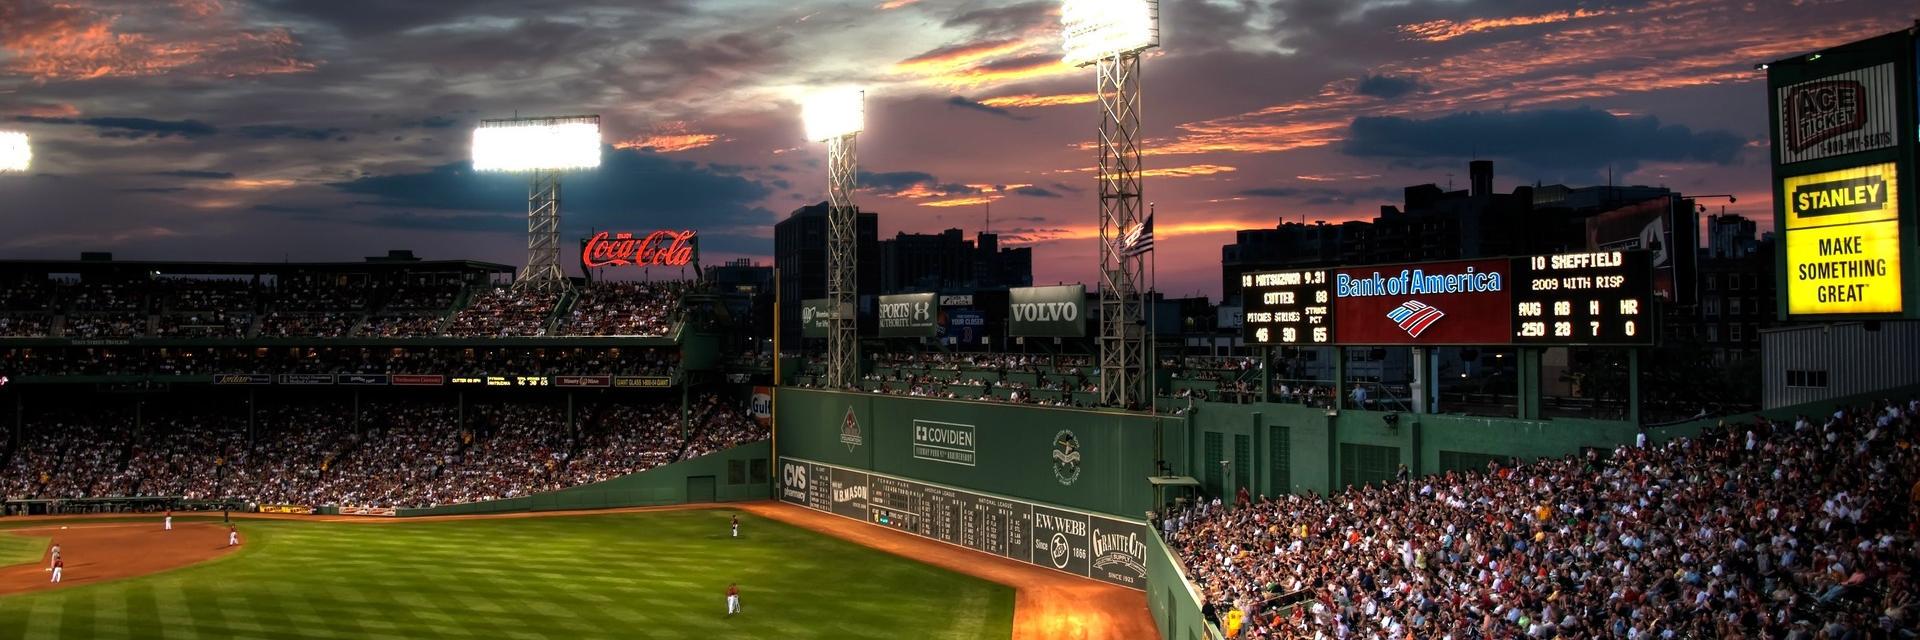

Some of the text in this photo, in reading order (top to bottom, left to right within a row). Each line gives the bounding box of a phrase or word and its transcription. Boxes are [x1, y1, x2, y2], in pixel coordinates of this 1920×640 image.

[1800, 87, 1856, 116] ACE
[1800, 109, 1856, 138] TICKET
[1798, 183, 1880, 211] STANLEY
[583, 230, 697, 267] Coca-Cola
[1818, 236, 1863, 257] MAKE
[1531, 252, 1622, 270] 10 SHEFFIELD
[1798, 258, 1887, 281] SOMETHING
[1304, 271, 1326, 285] 9.31
[1337, 266, 1502, 298] Bank of America
[1532, 276, 1624, 290] 2009 WITH RISP
[1264, 290, 1328, 305] CUTTER 88
[1011, 301, 1078, 322] VOLVO
[1518, 299, 1638, 316] AVG AB H HR
[1247, 312, 1272, 323] PITCHES
[1274, 312, 1301, 322] STRIKES
[1309, 316, 1323, 324] PCT
[1255, 327, 1327, 342] 46 30 65
[1516, 321, 1635, 336] .250 28 7 0
[928, 427, 973, 447] COVIDIEN
[783, 463, 806, 490] CVS
[783, 487, 807, 502] pharmacy
[924, 487, 942, 495] AMERICAN
[942, 489, 956, 497] LEAGUE
[978, 498, 1013, 509] NATIONAL LEAGUE
[1036, 513, 1086, 537] F.W. WEBB
[1035, 538, 1049, 551] Since
[1092, 528, 1129, 558] GRANITE
[1108, 572, 1122, 581] SINCE
